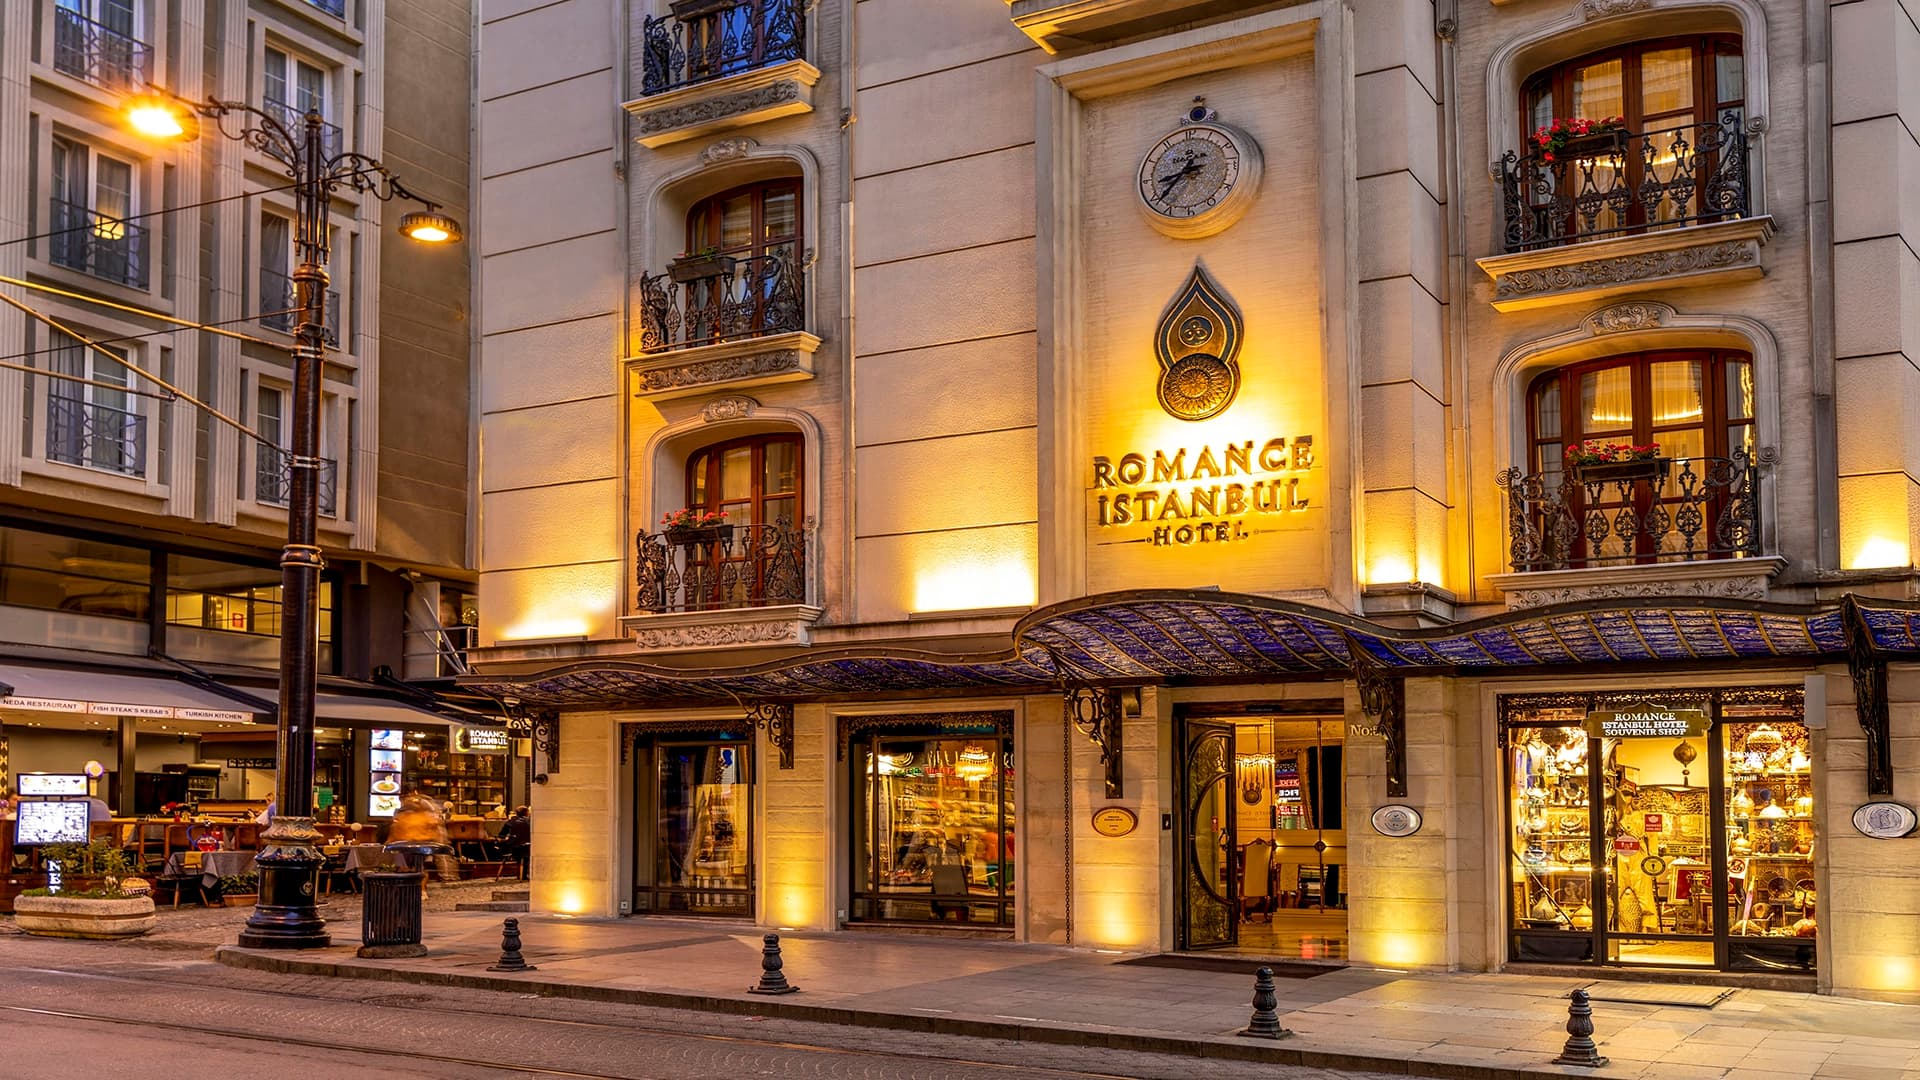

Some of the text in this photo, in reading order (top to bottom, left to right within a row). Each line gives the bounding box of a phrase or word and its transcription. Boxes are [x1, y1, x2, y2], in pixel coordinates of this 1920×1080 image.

[1093, 435, 1314, 489] ROMANCE
[1098, 478, 1310, 528] ISTANBUL
[1152, 520, 1249, 547] HOTEL
[26, 700, 78, 710] RESTAURANT
[1614, 712, 1676, 721] ROMANCE
[1602, 720, 1689, 729] ISTANBUL HOTEL
[1605, 728, 1687, 736] SOUVENIR SHOP
